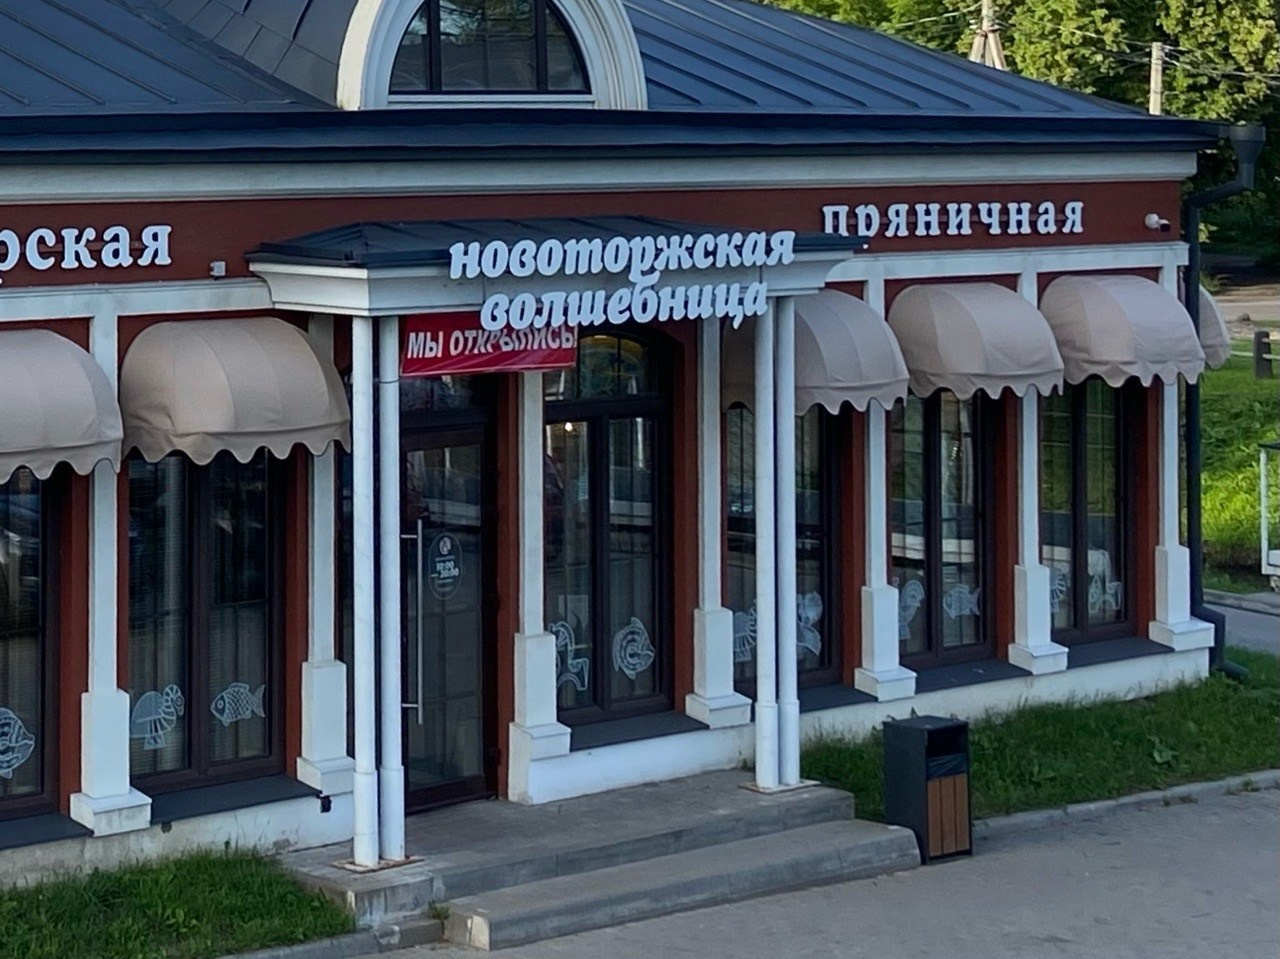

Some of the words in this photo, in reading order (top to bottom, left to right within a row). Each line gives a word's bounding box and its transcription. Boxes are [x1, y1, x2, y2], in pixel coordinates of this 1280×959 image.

[822, 200, 1084, 238] пряничная
[449, 230, 796, 284] новоторжская
[480, 271, 769, 330] волшебница
[407, 331, 442, 358] МЫ
